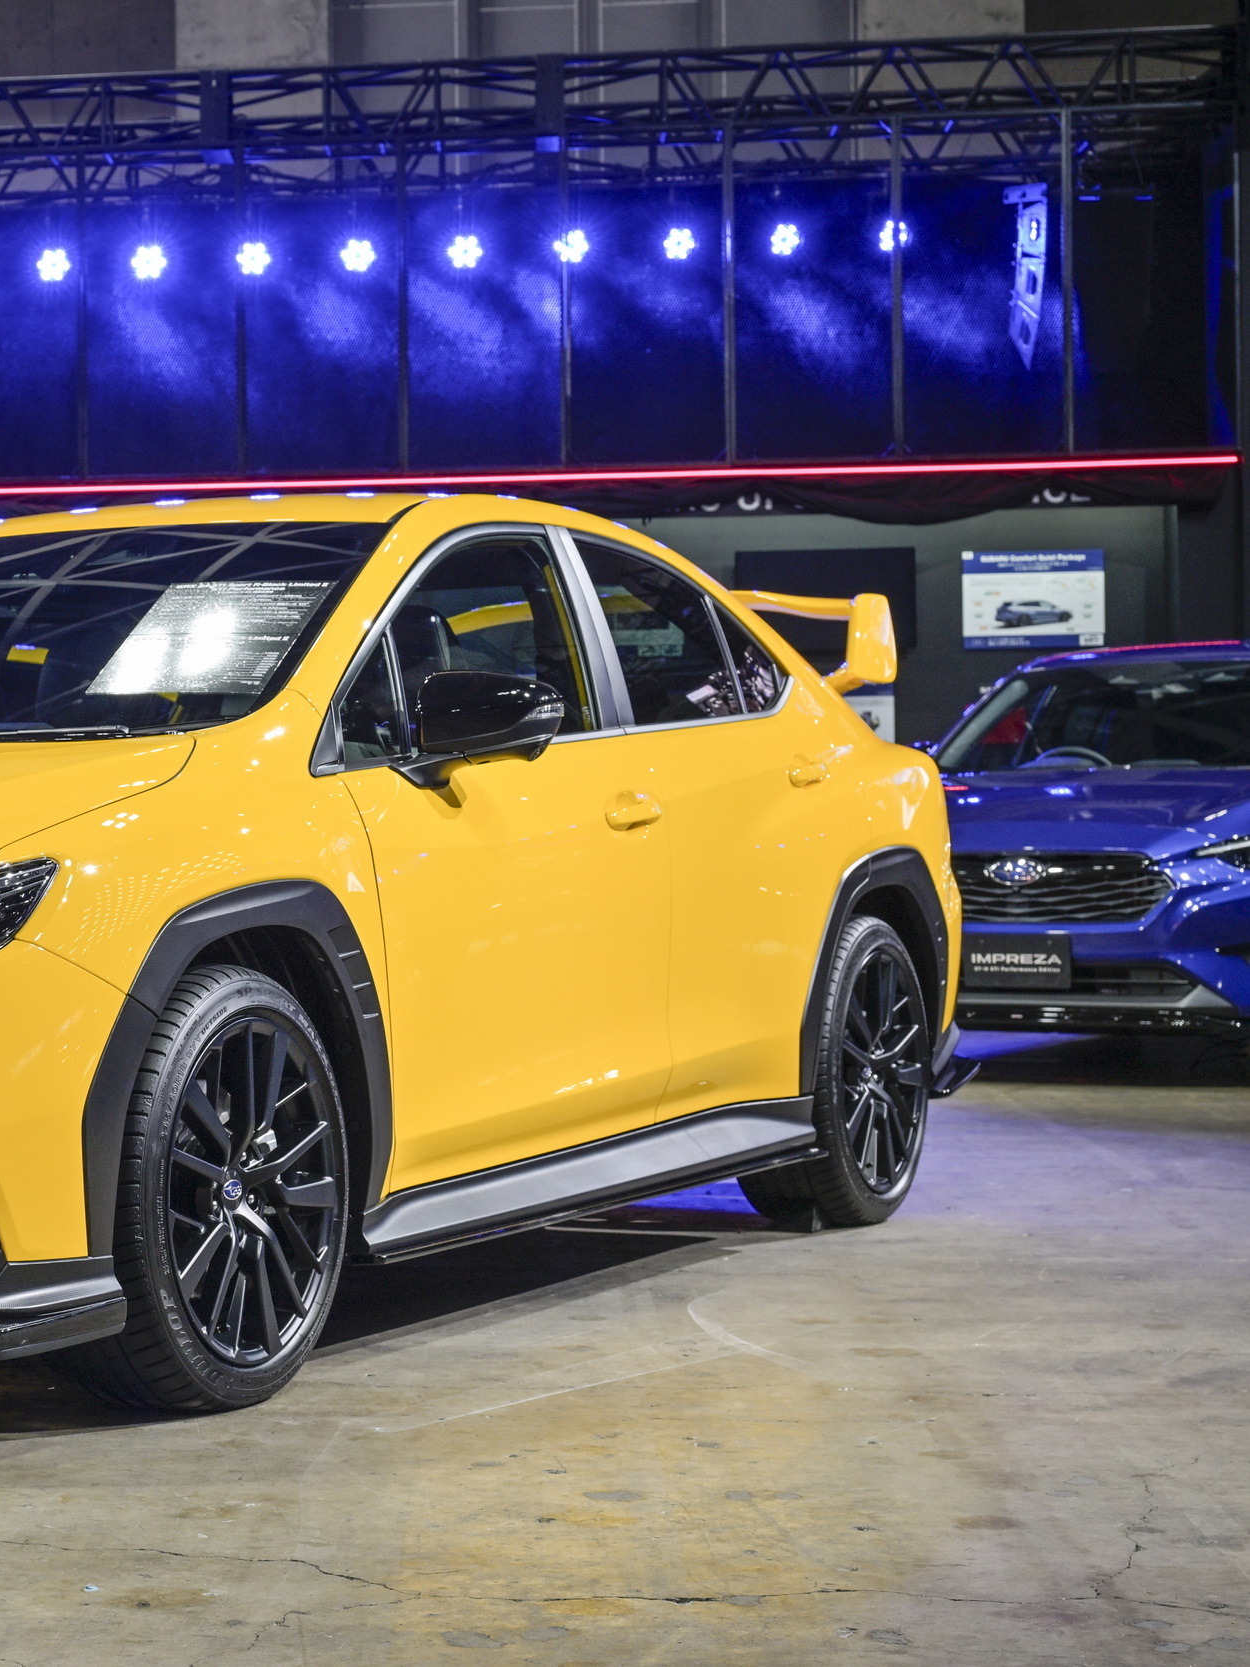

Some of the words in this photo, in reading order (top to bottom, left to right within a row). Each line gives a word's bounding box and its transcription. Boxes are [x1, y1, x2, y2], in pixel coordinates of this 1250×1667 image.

[1057, 552, 1086, 562] Package
[970, 953, 1062, 965] IMPREZA
[201, 1006, 228, 1035] OUTSIDE
[159, 1289, 224, 1386] DUNLOP
